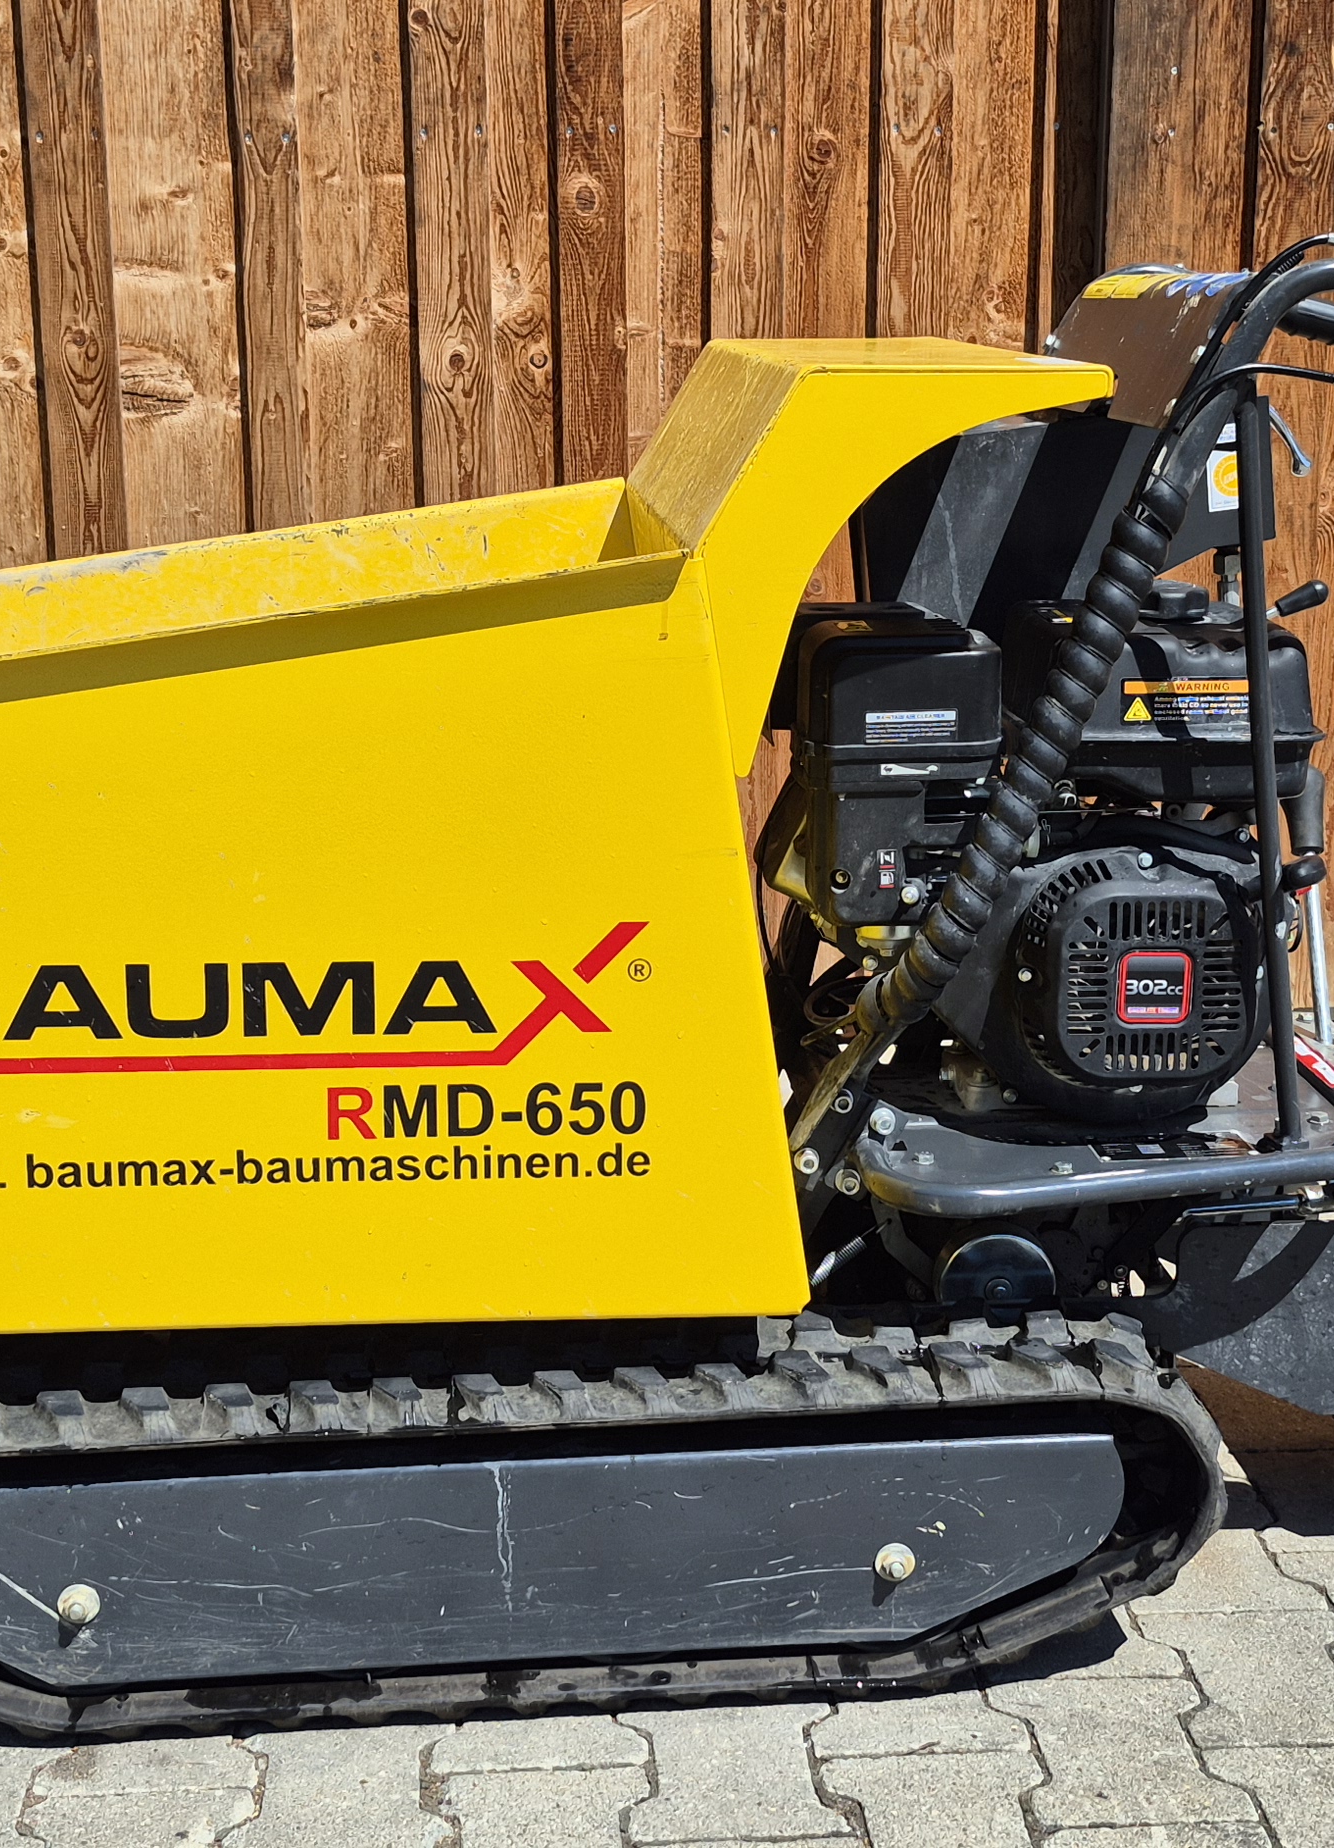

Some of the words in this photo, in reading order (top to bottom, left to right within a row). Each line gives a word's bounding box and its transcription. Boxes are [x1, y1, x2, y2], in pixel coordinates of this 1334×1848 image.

[1175, 682, 1230, 691] WARNING
[1125, 979, 1184, 995] 302cc
[327, 1081, 647, 1140] RMD-650
[26, 1143, 651, 1189] baumax-baumaschinen.de
